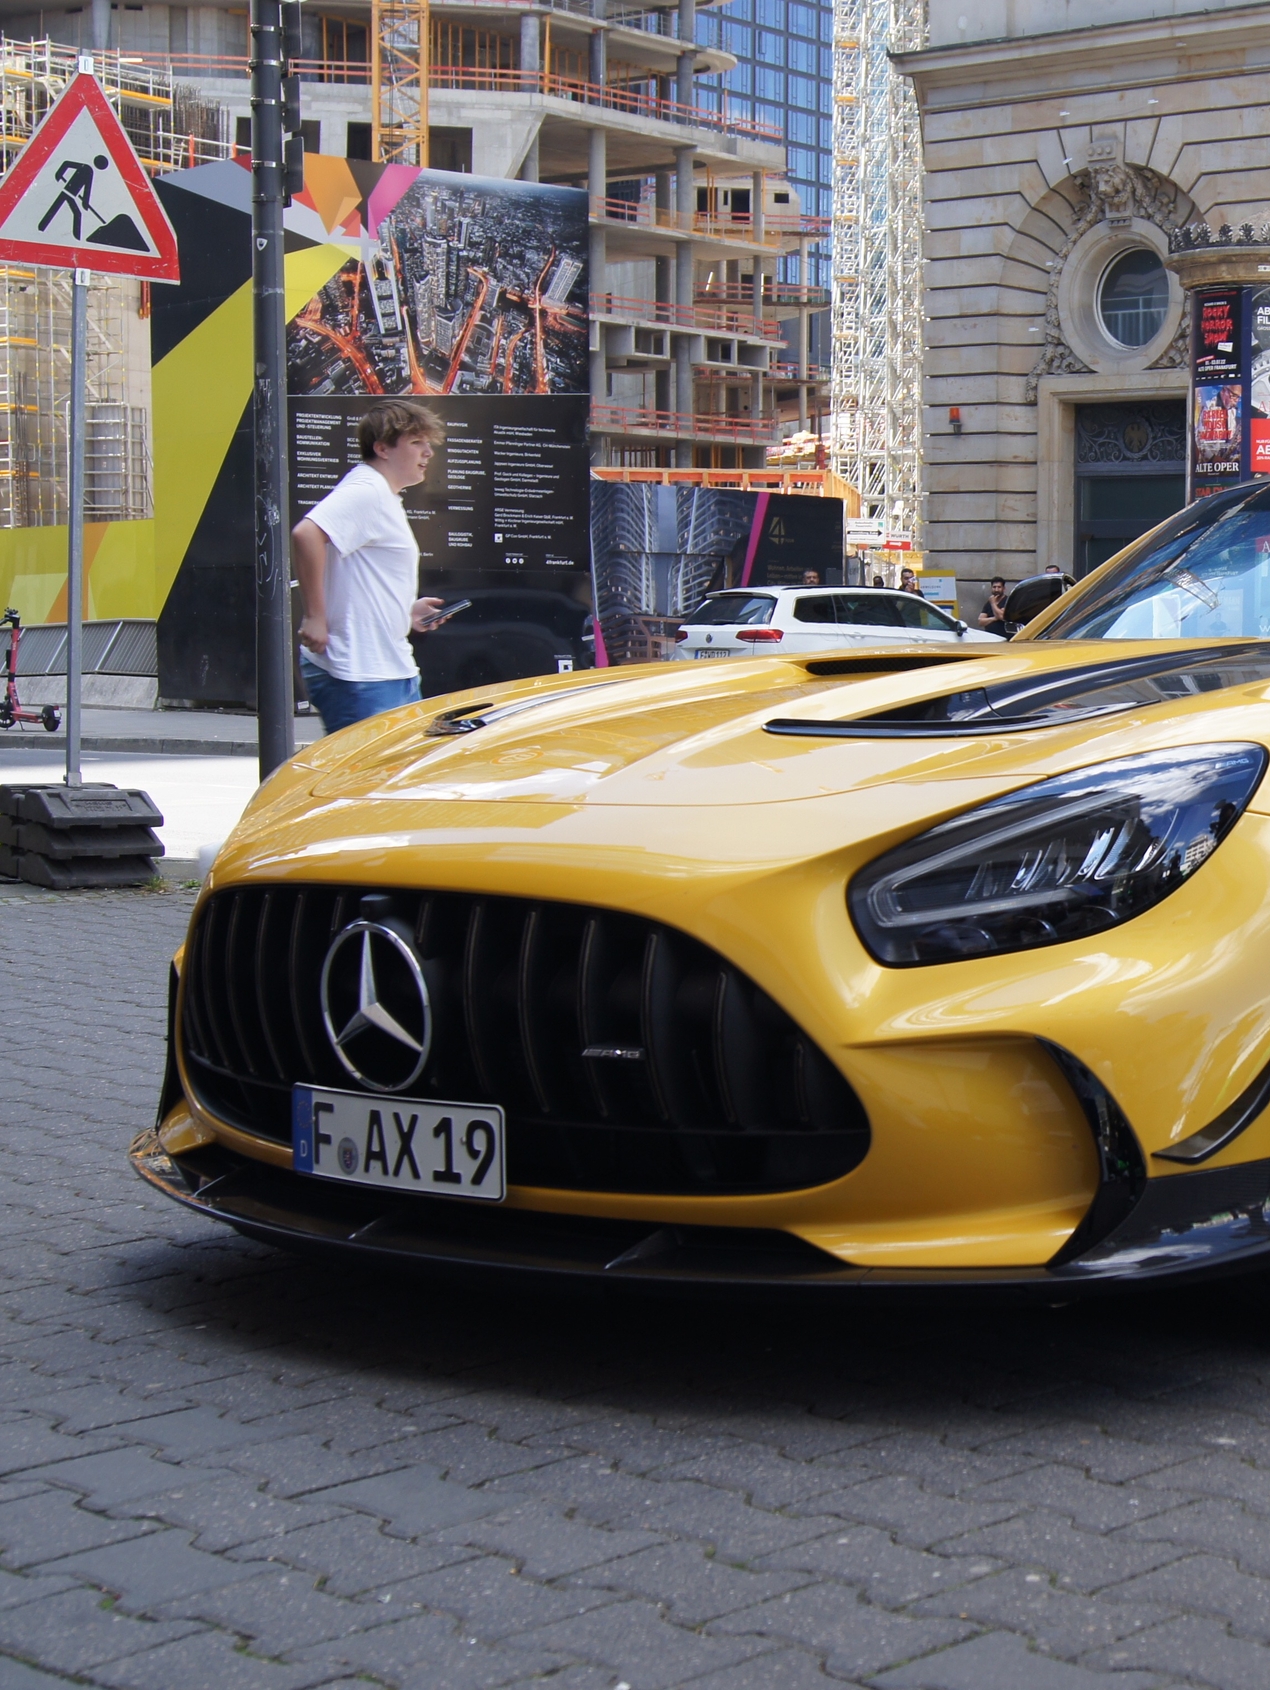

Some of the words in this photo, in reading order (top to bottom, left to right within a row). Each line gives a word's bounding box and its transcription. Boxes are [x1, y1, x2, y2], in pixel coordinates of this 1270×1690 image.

[1203, 305, 1230, 318] ROCKY
[1202, 319, 1233, 332] HORROR
[1204, 331, 1228, 346] SHOW
[296, 412, 342, 420] PROJEKTENTWICKLUNG
[1196, 463, 1213, 473] ALTE
[1214, 462, 1239, 472] OPER
[1226, 758, 1249, 766] AMG
[300, 1140, 308, 1157] D
[314, 1102, 334, 1164] F
[364, 1110, 421, 1179] AX
[433, 1117, 496, 1185] 19
